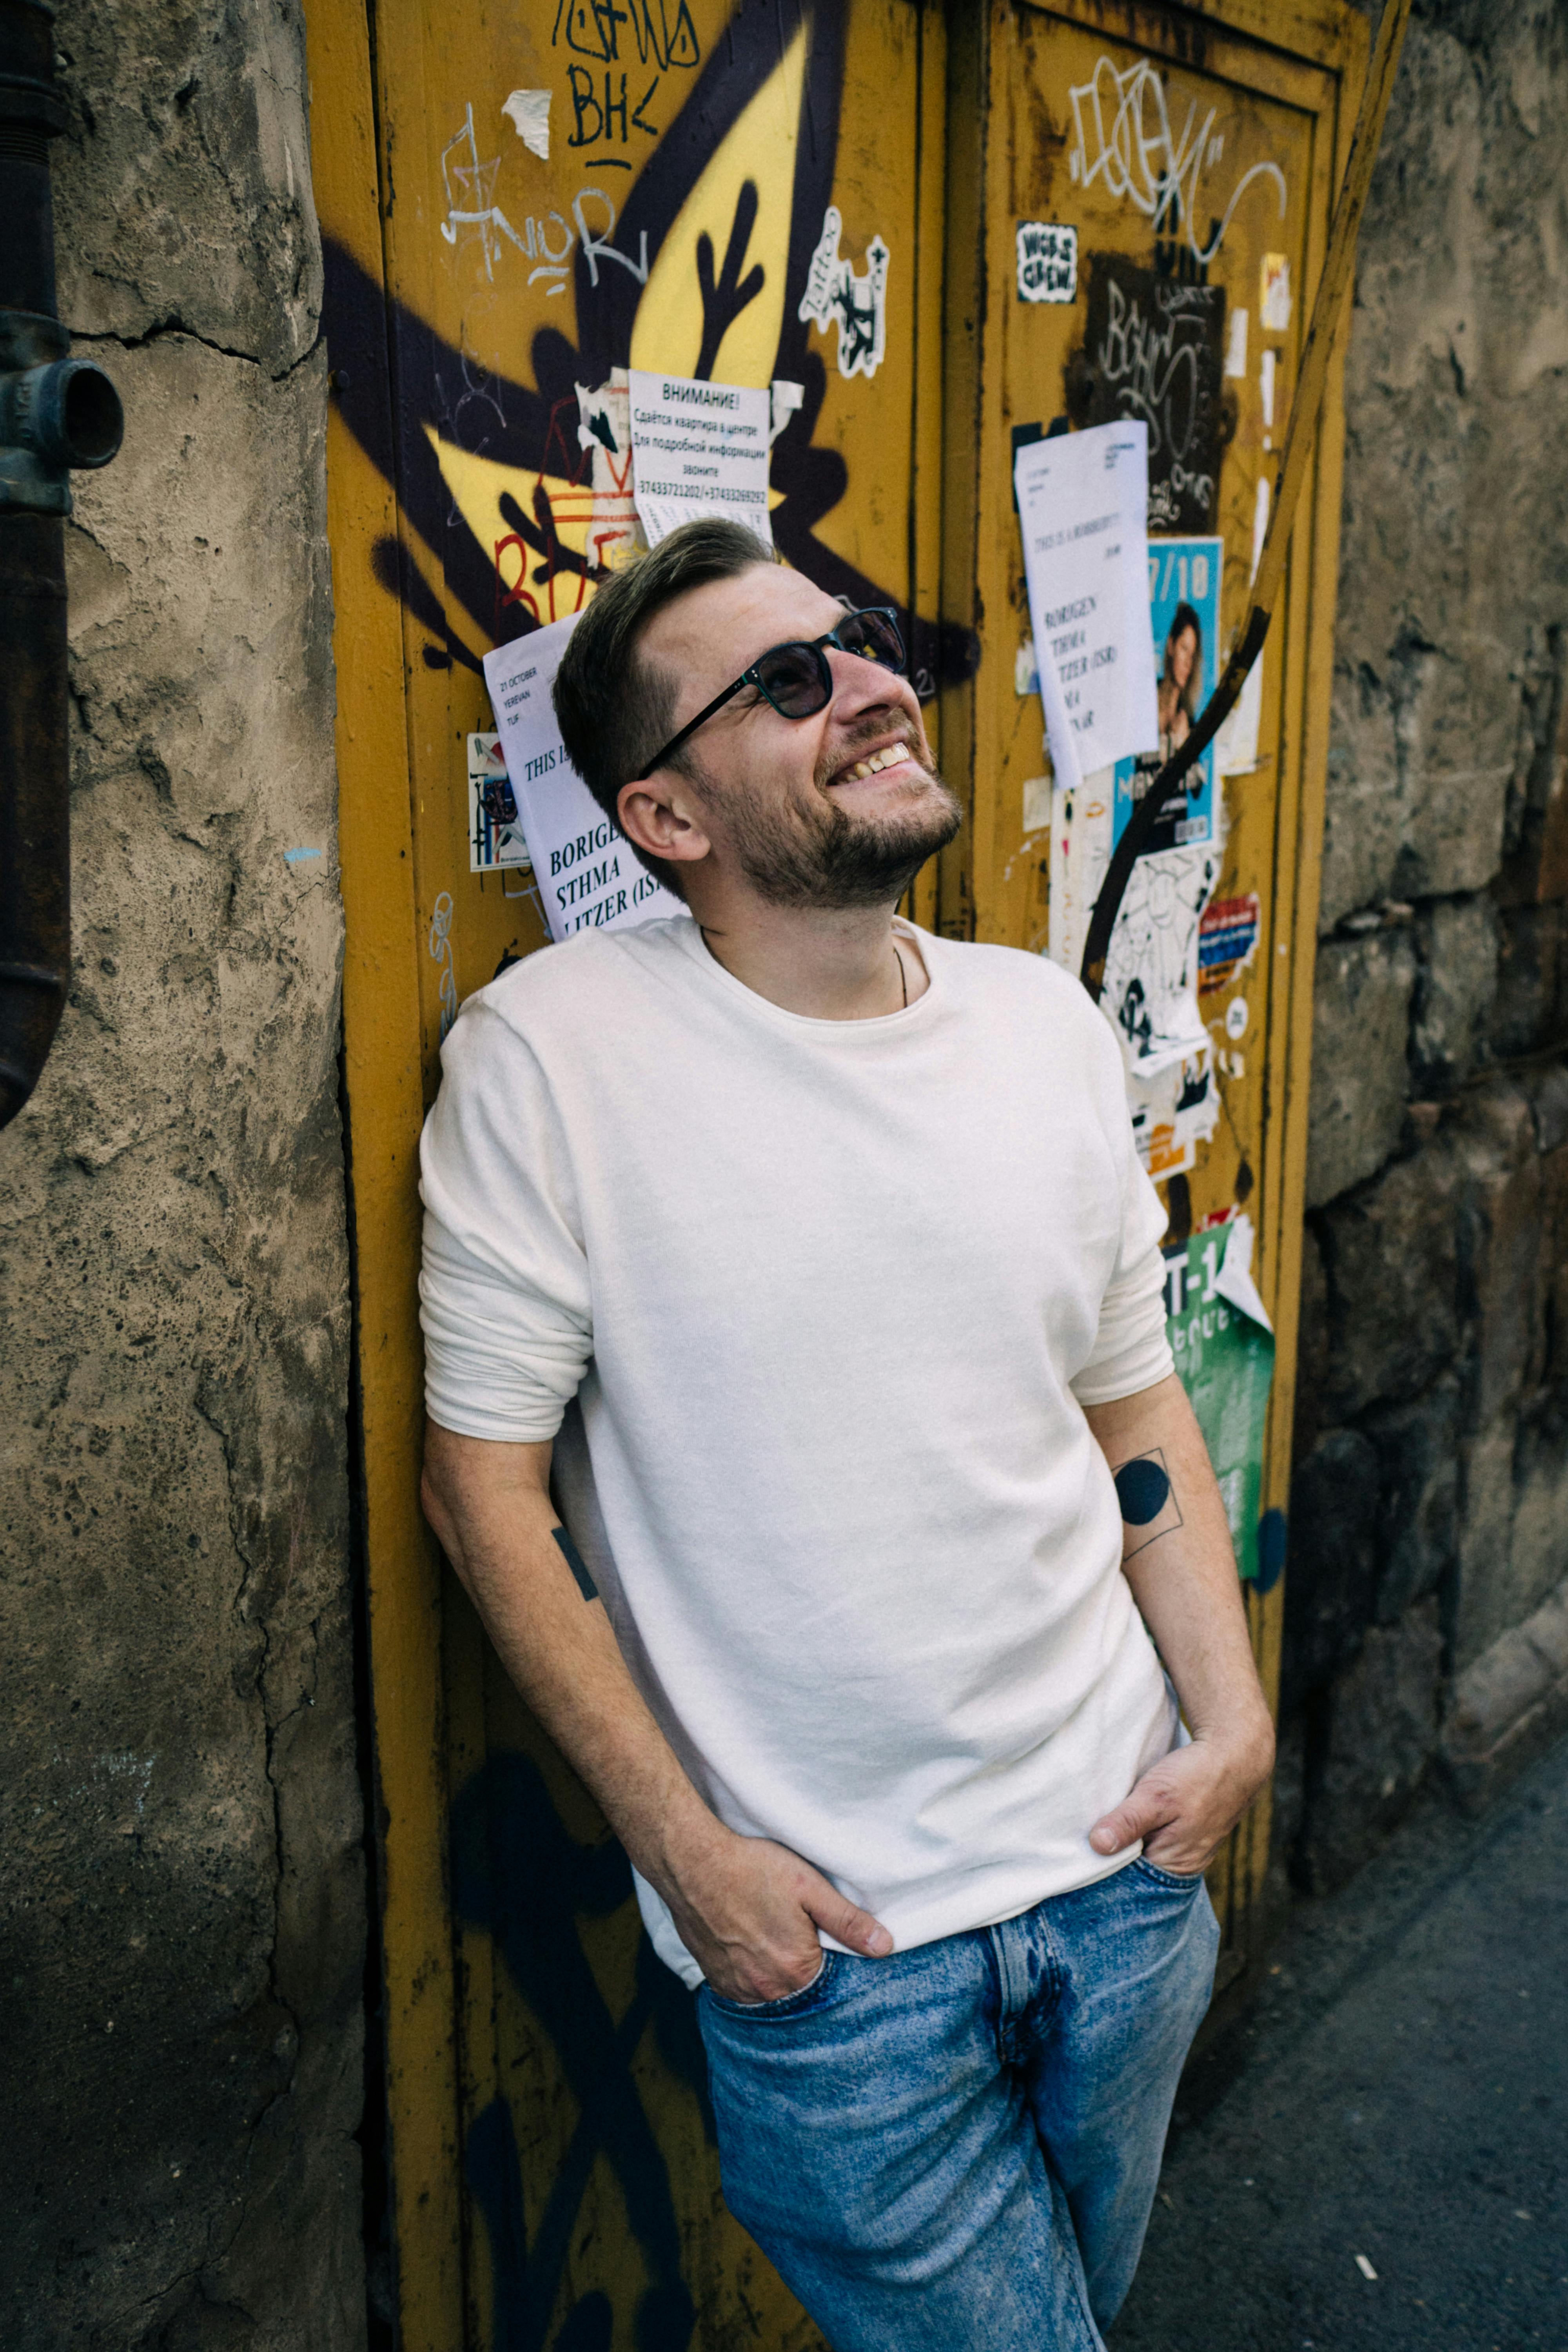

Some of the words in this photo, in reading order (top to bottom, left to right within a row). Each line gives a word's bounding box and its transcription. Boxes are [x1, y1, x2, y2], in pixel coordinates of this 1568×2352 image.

[662, 383, 740, 410] ВНИМАНИЕ!
[634, 408, 672, 426] Сдаётся
[674, 417, 717, 432] квартира
[720, 423, 725, 433] в
[726, 425, 757, 438] центре
[634, 432, 650, 448] Для
[652, 438, 706, 453] подробной
[708, 445, 766, 459] информации
[683, 465, 719, 477] звоните
[500, 682, 507, 692] 21
[509, 667, 537, 688] OCTOBER
[503, 690, 531, 709] YEREVAN
[507, 714, 519, 726] TUF
[524, 748, 556, 781] THIS
[557, 855, 620, 911] STHMA
[633, 874, 661, 908] (IS
